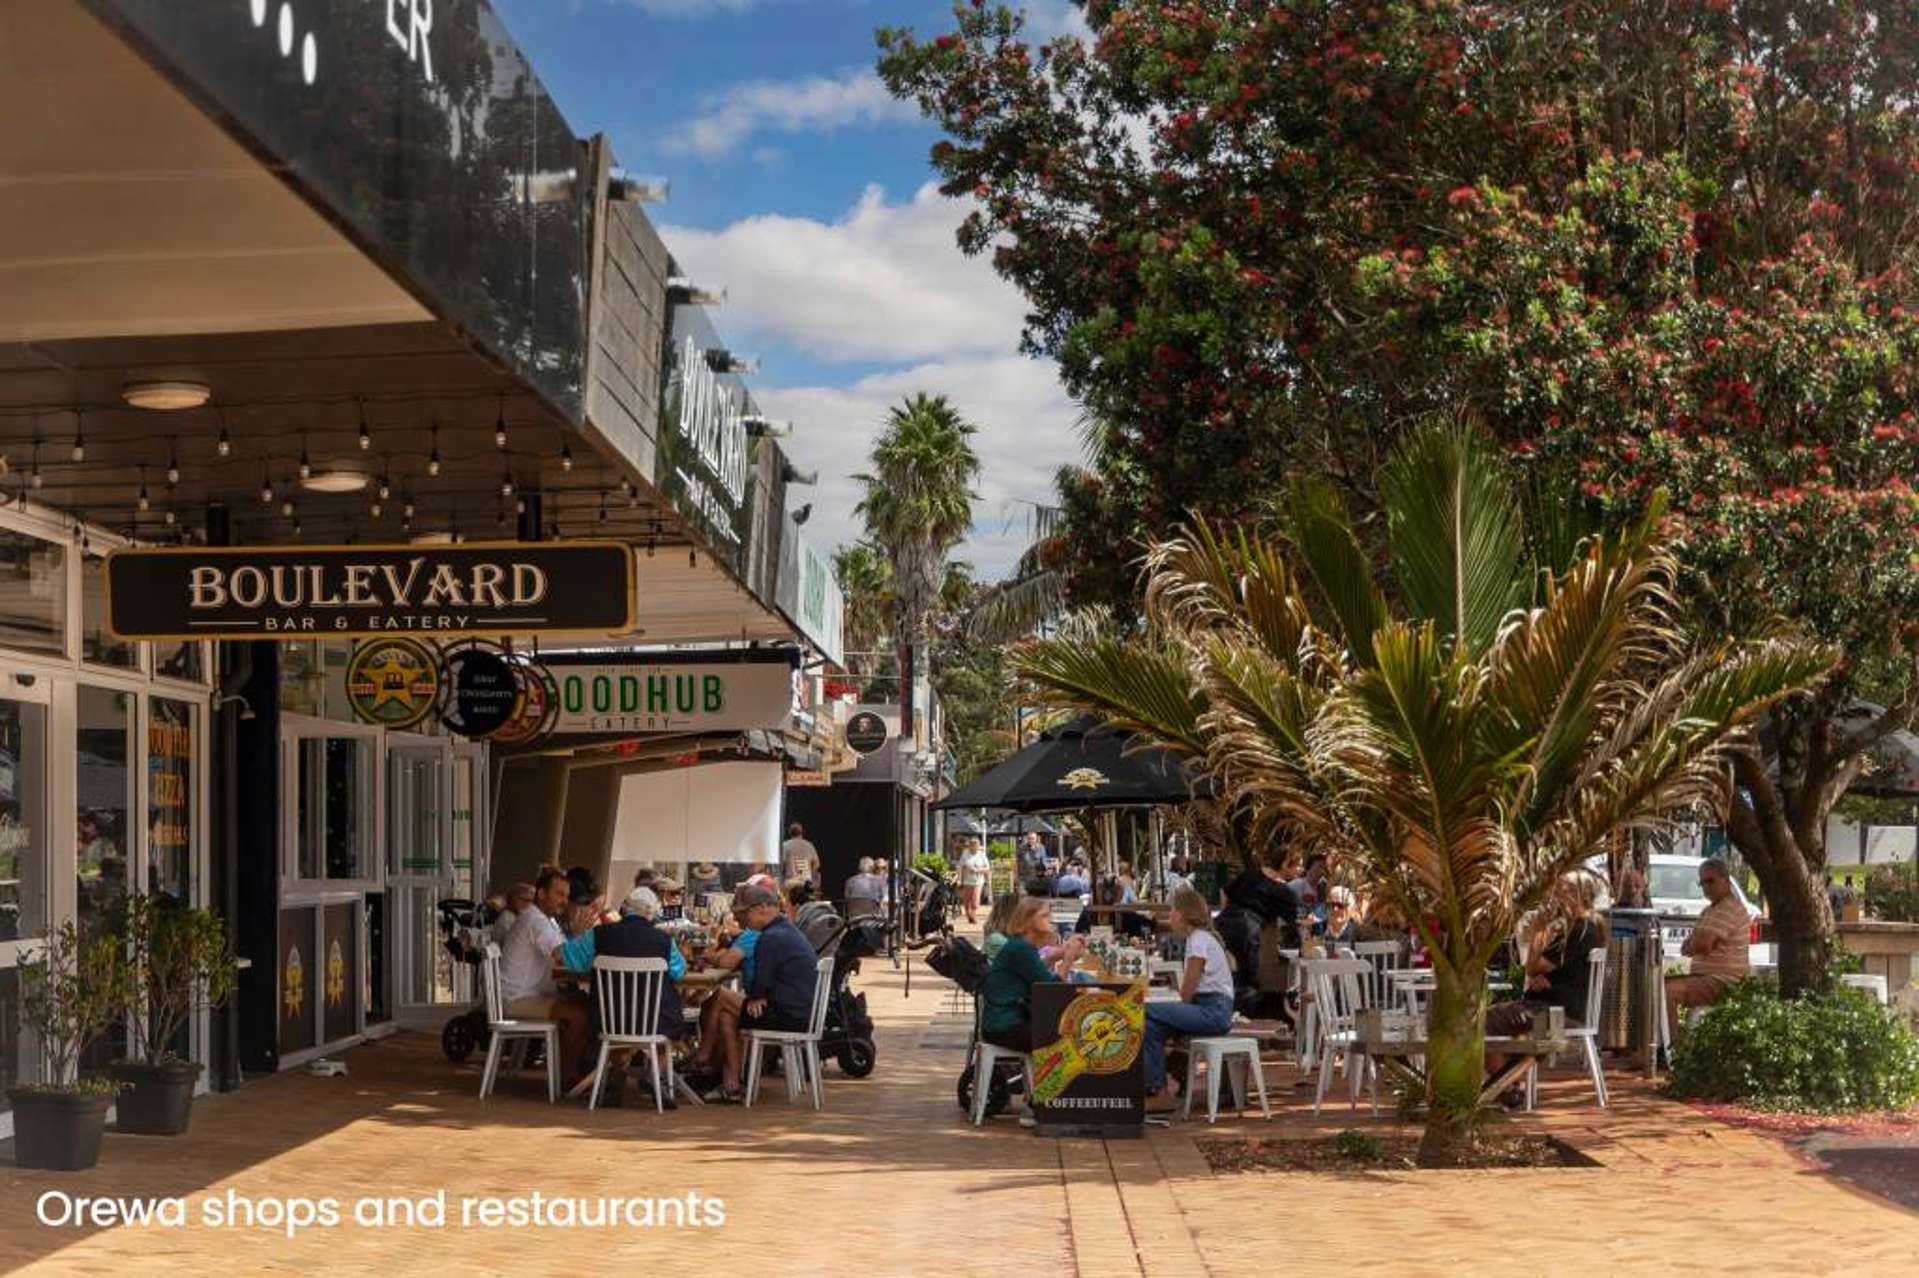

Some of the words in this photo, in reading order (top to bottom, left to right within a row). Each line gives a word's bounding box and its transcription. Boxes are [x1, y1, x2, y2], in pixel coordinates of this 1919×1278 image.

[189, 559, 547, 609] BOULEVARD
[264, 617, 315, 630] BAR
[335, 616, 348, 629] &
[369, 614, 470, 629] EATERY
